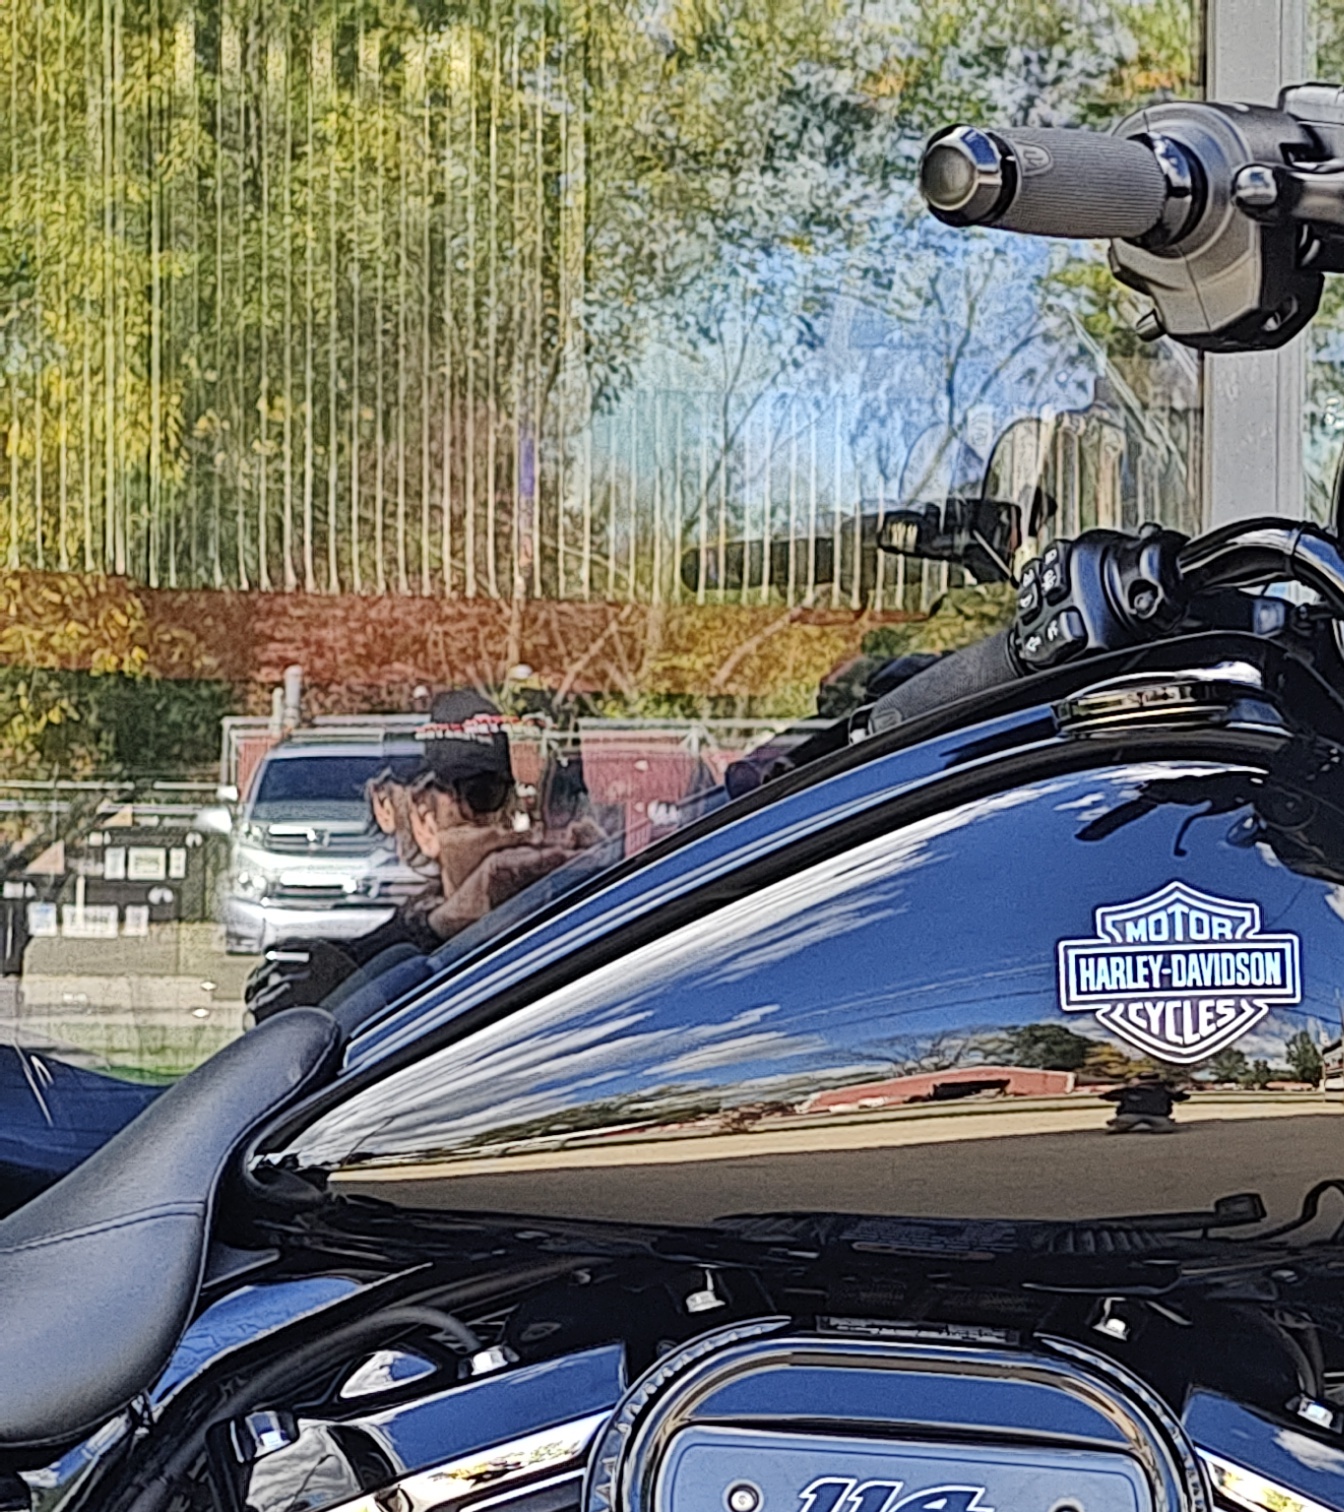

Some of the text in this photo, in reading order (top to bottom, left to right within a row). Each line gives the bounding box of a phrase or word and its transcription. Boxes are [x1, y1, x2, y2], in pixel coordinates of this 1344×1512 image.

[1125, 901, 1233, 942] MOTOR
[1079, 951, 1281, 991] HARLEY-DAVIDSON
[1128, 999, 1236, 1045] CYCLES
